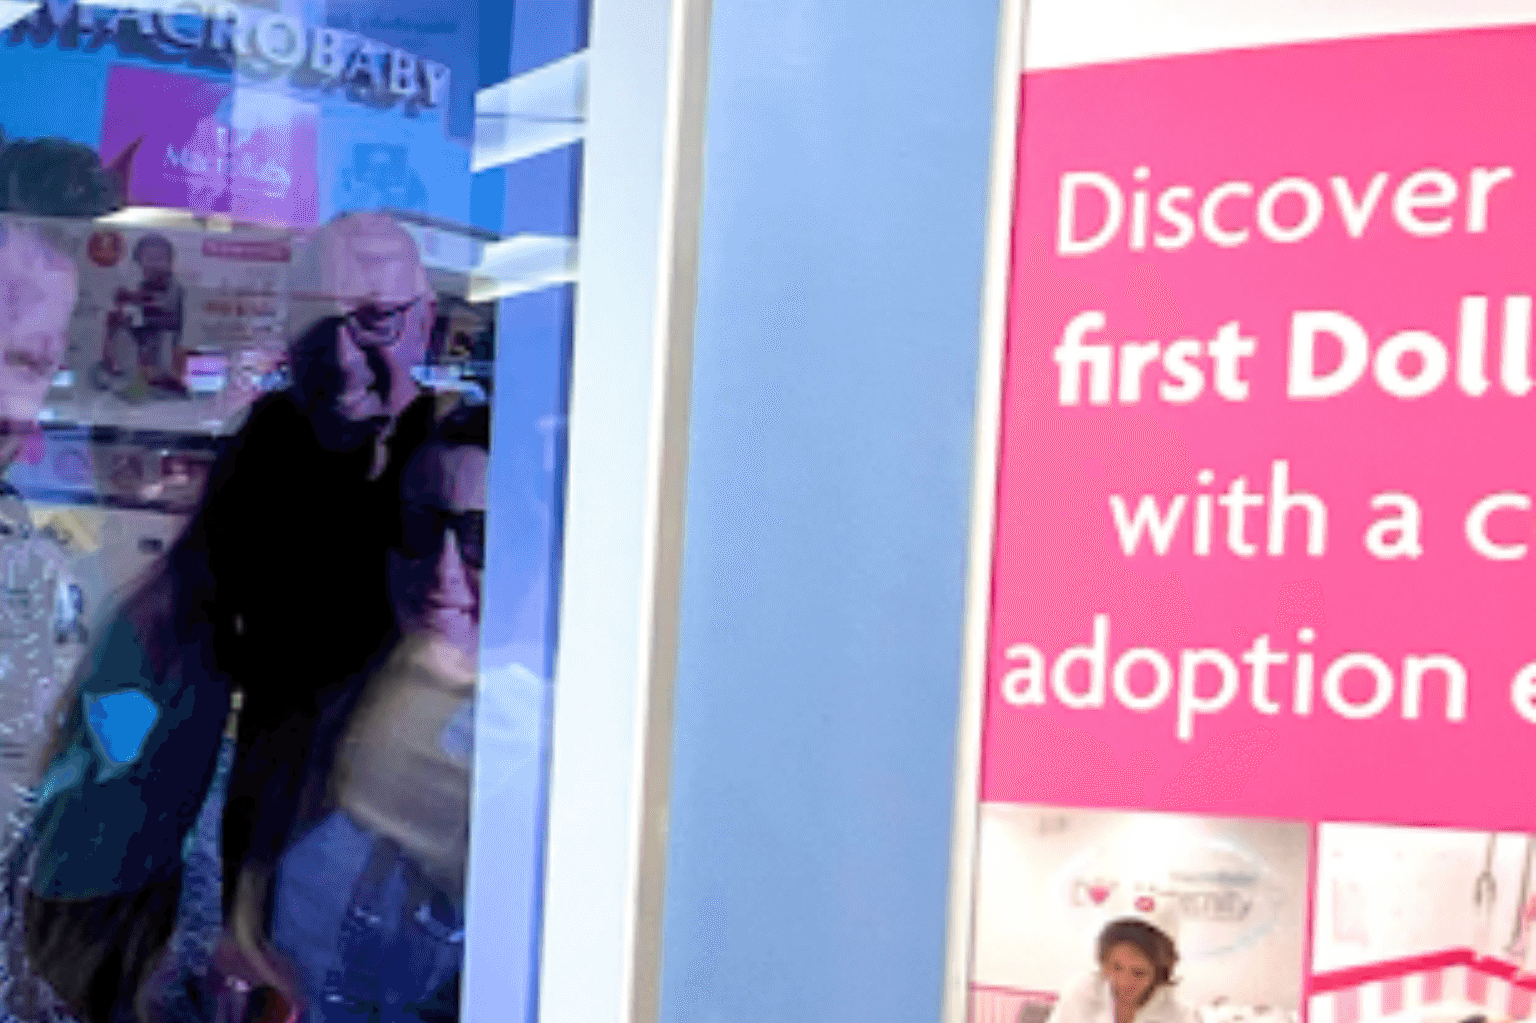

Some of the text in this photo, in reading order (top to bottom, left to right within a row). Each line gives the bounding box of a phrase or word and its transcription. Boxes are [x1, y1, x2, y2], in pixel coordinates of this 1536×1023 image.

[1055, 164, 1514, 259] Discover
[1052, 294, 1534, 407] first Doll
[1106, 458, 1328, 559] with
[1363, 490, 1426, 561] a
[999, 611, 1468, 742] adoption
